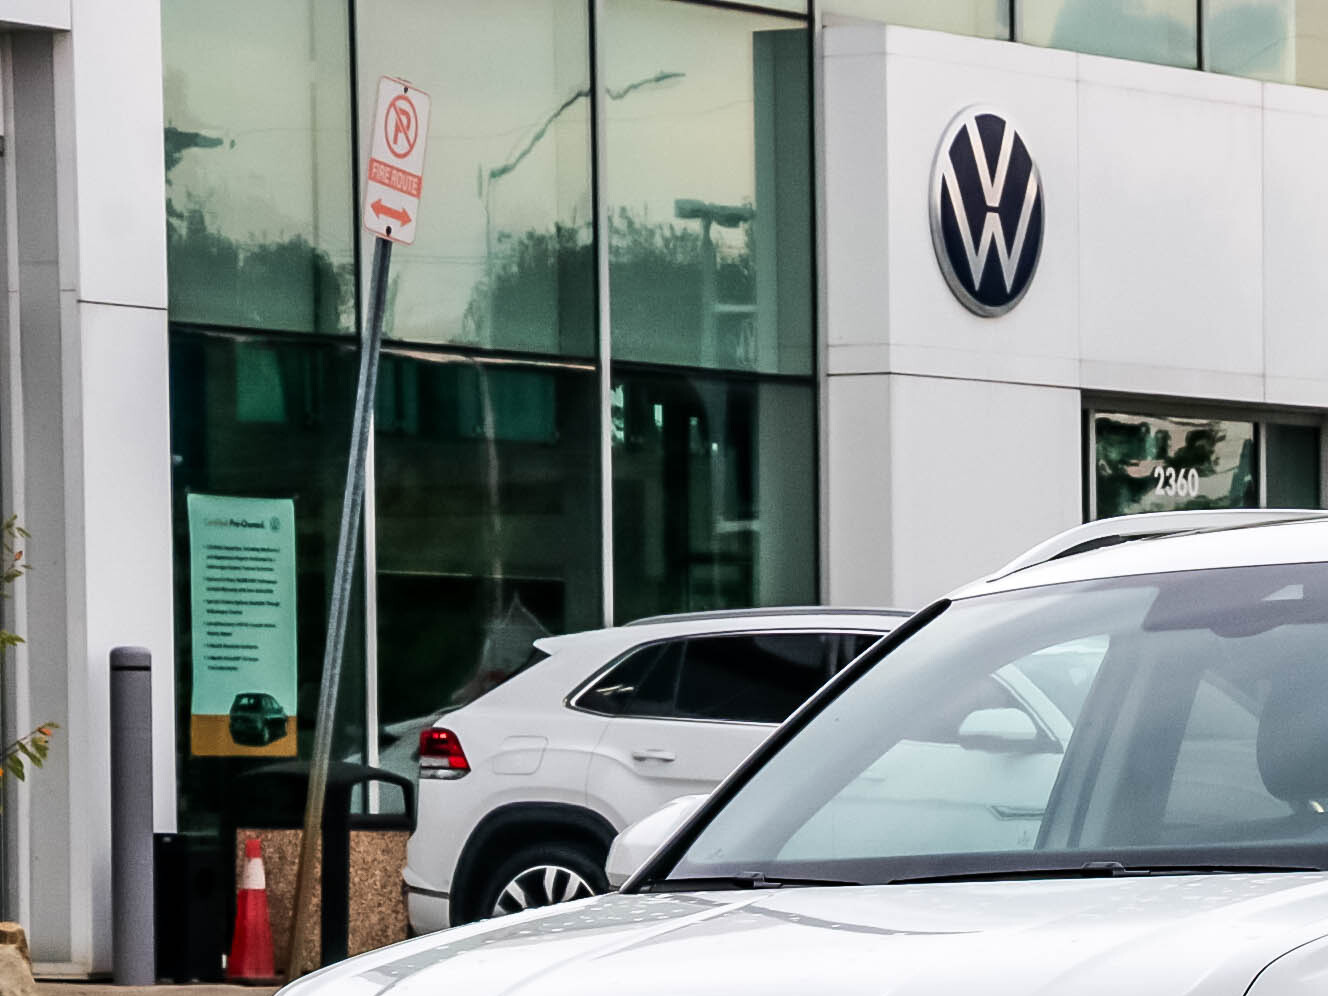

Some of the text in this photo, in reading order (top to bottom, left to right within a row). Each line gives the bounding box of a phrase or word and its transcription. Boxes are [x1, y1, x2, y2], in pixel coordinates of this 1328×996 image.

[371, 161, 418, 195] FIRE ROUTE
[940, 110, 1041, 296] VW
[1154, 466, 1199, 496] 2360
